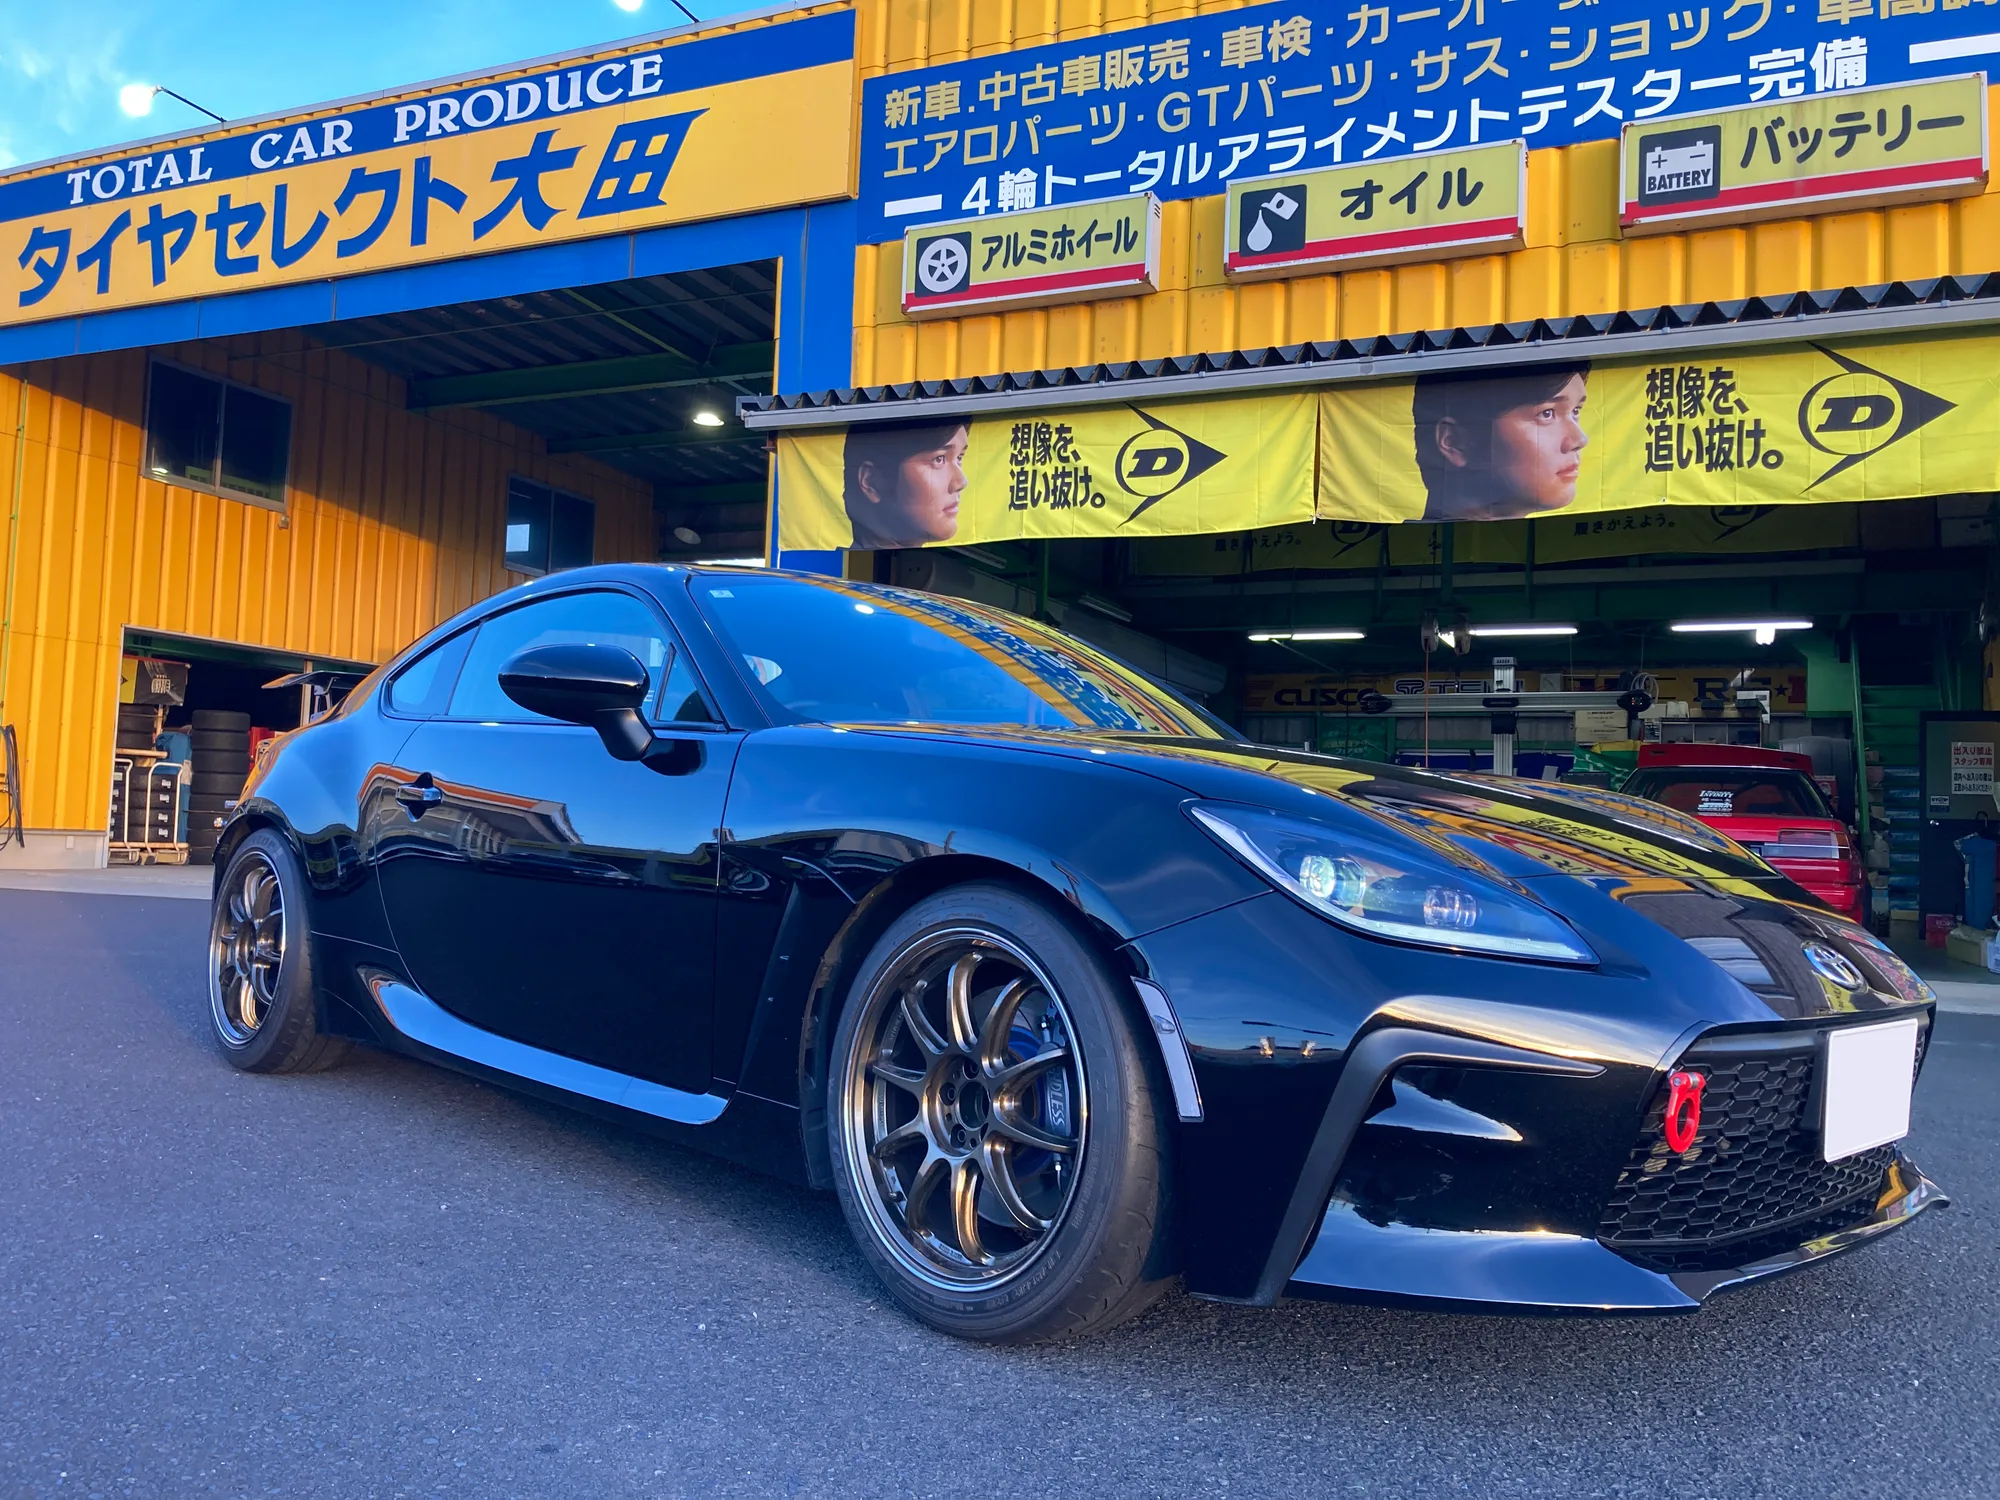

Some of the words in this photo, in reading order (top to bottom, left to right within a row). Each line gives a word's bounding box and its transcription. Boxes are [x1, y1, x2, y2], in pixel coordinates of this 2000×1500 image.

[67, 146, 212, 205] TOTAL
[250, 119, 353, 170] CAR
[394, 53, 664, 143] PRODUCE
[1741, 104, 1965, 169] バッテリー
[1340, 166, 1484, 220] オイル
[1647, 168, 1712, 191] BATTERY
[18, 106, 708, 308] タイヤセレクト大田
[981, 216, 1138, 272] アルミホイール
[1645, 366, 1749, 420] 想像を、
[1009, 422, 1080, 466] 想像を、
[1645, 418, 1784, 474] 追い抜け。
[1008, 466, 1106, 513] 追い抜け。
[1953, 747, 1993, 756] 出入り禁止
